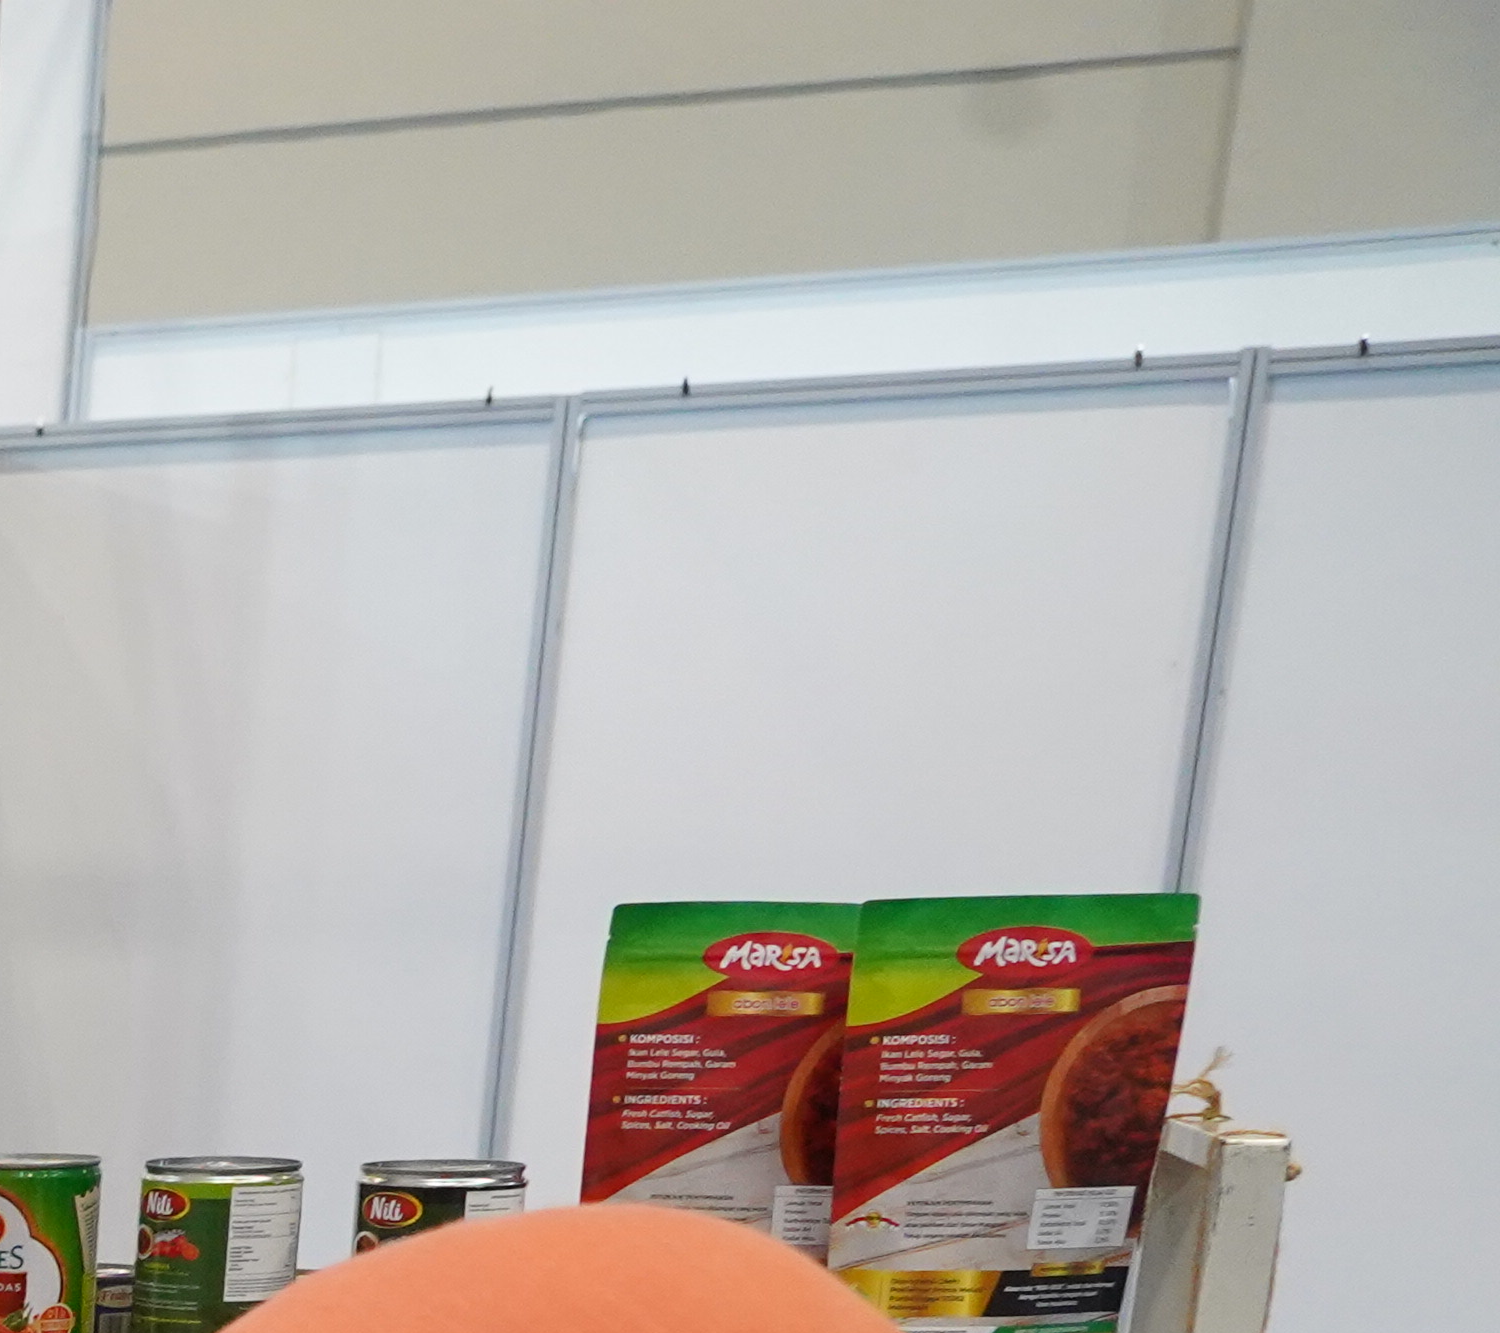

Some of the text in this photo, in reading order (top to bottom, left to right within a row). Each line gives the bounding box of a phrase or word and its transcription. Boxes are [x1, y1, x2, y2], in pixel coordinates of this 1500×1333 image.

[629, 1033, 695, 1045] KOMPOSISI
[882, 1035, 950, 1046] KOMPOSISI
[623, 1095, 702, 1106] INGREDIENTS
[876, 1098, 958, 1108] INGREDIENTS
[145, 1190, 174, 1216] Nili
[368, 1195, 405, 1222] Nili
